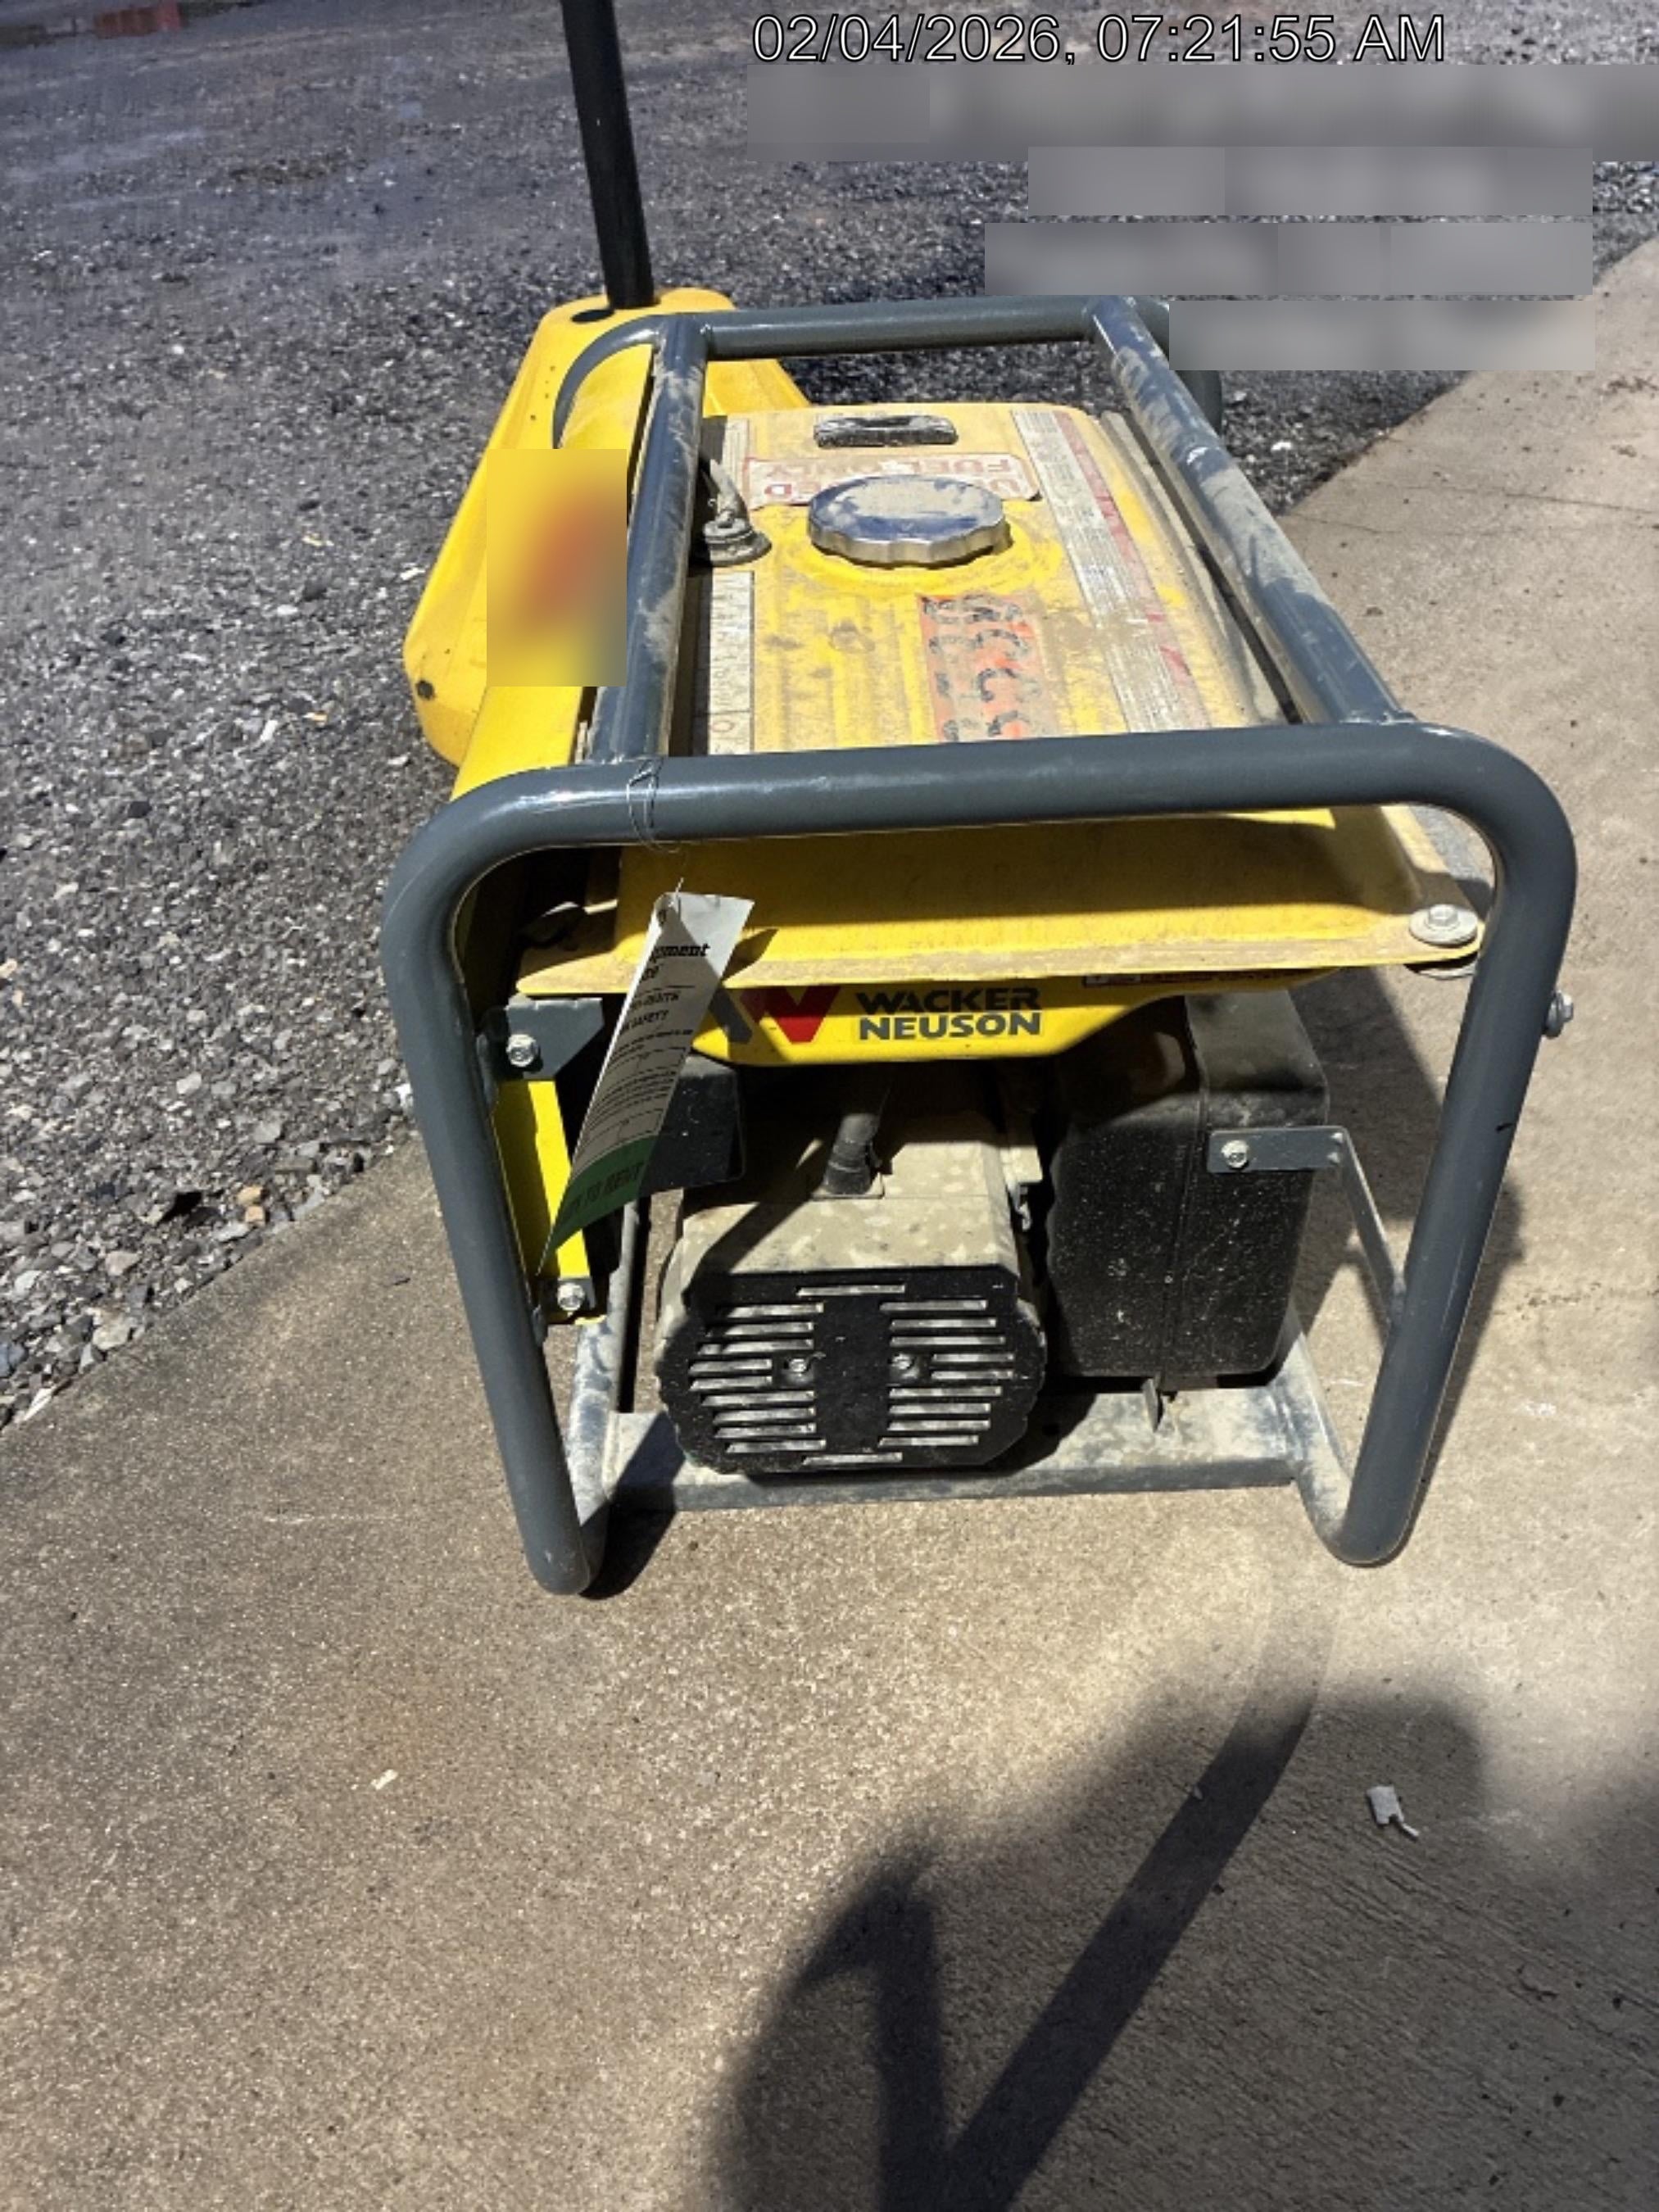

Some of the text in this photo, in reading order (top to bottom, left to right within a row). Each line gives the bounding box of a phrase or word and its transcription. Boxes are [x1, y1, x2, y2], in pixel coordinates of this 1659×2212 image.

[895, 458, 1012, 475] FUEL
[856, 988, 1040, 1014] WACKER
[859, 1013, 1040, 1040] NEUSON
